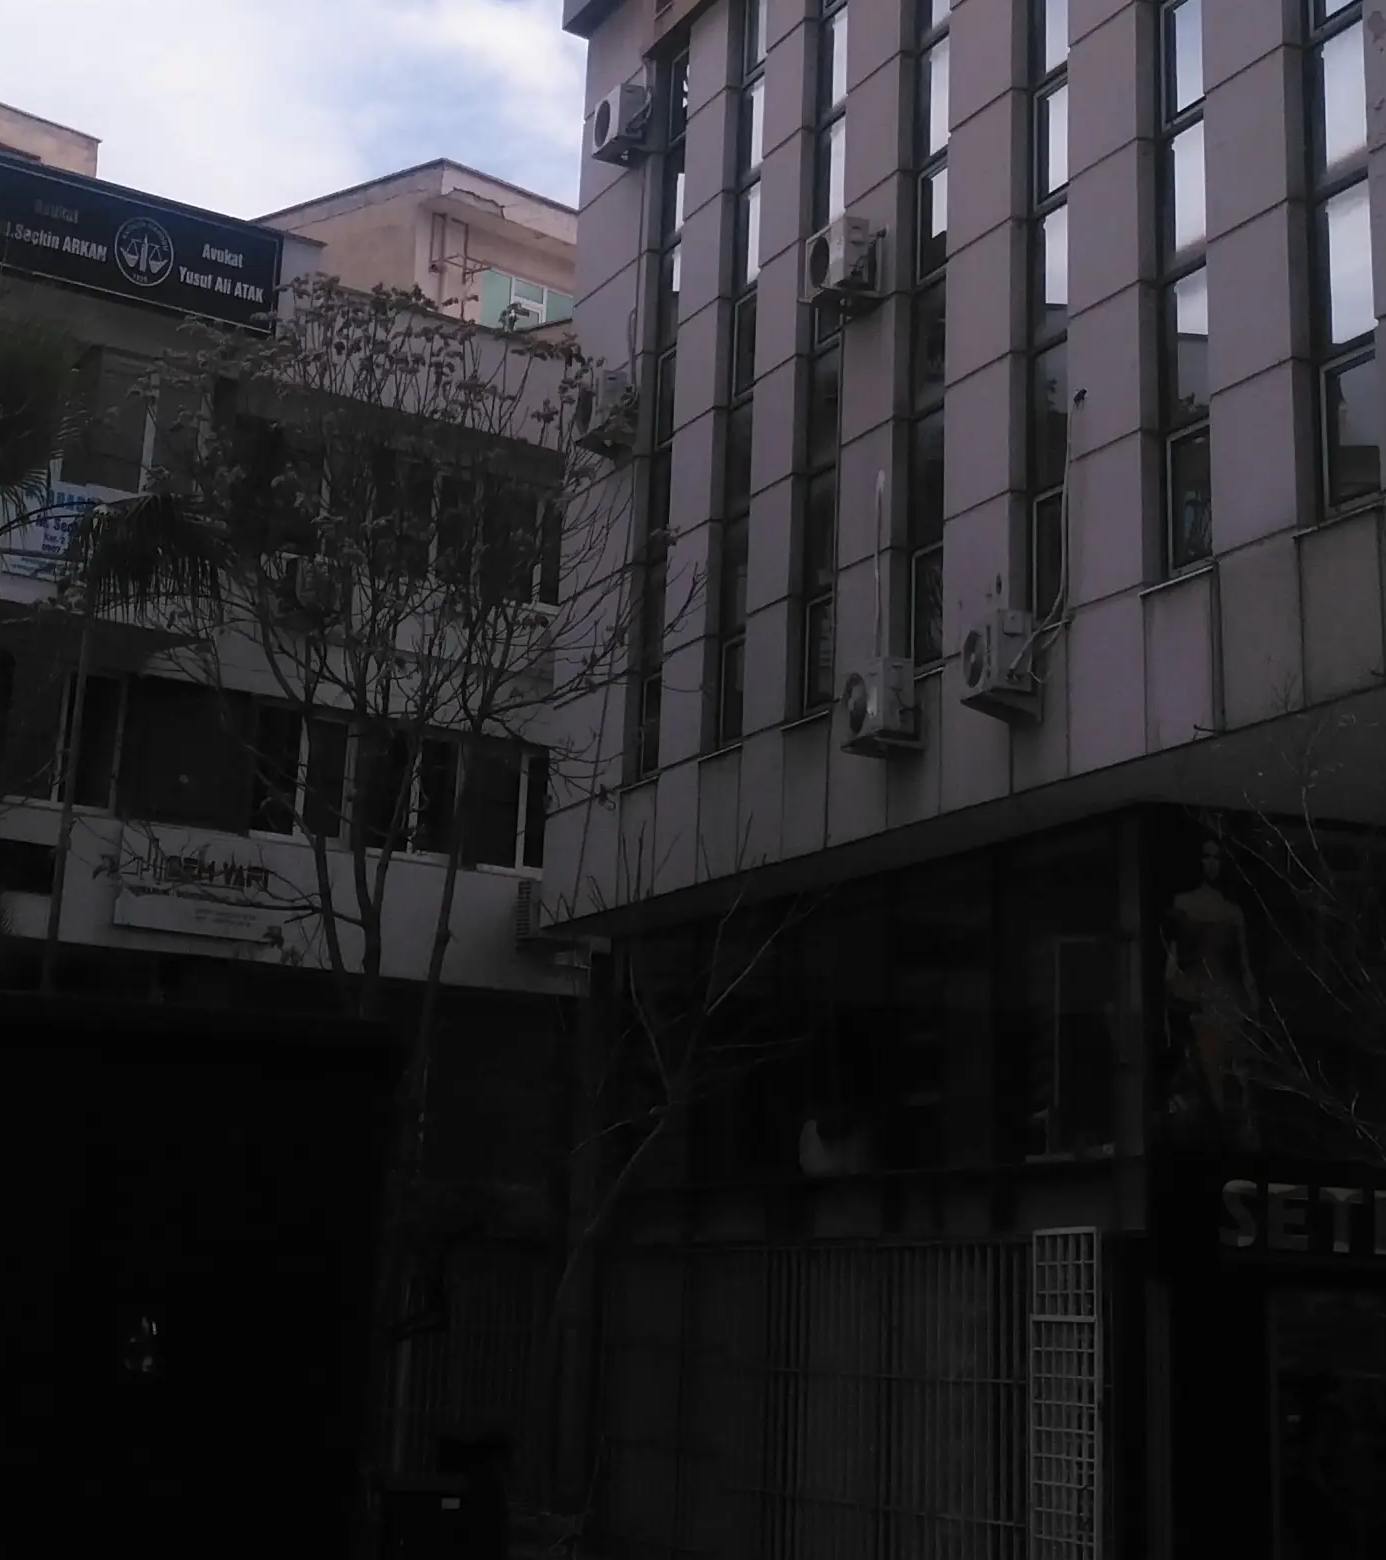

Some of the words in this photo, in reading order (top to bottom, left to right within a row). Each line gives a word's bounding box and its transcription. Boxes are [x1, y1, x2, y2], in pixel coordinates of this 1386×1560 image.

[62, 236, 108, 262] ARKAN
[202, 243, 244, 269] Avukat
[179, 265, 213, 289] Yusuf
[215, 276, 231, 295] Ali
[233, 281, 264, 303] ATAK
